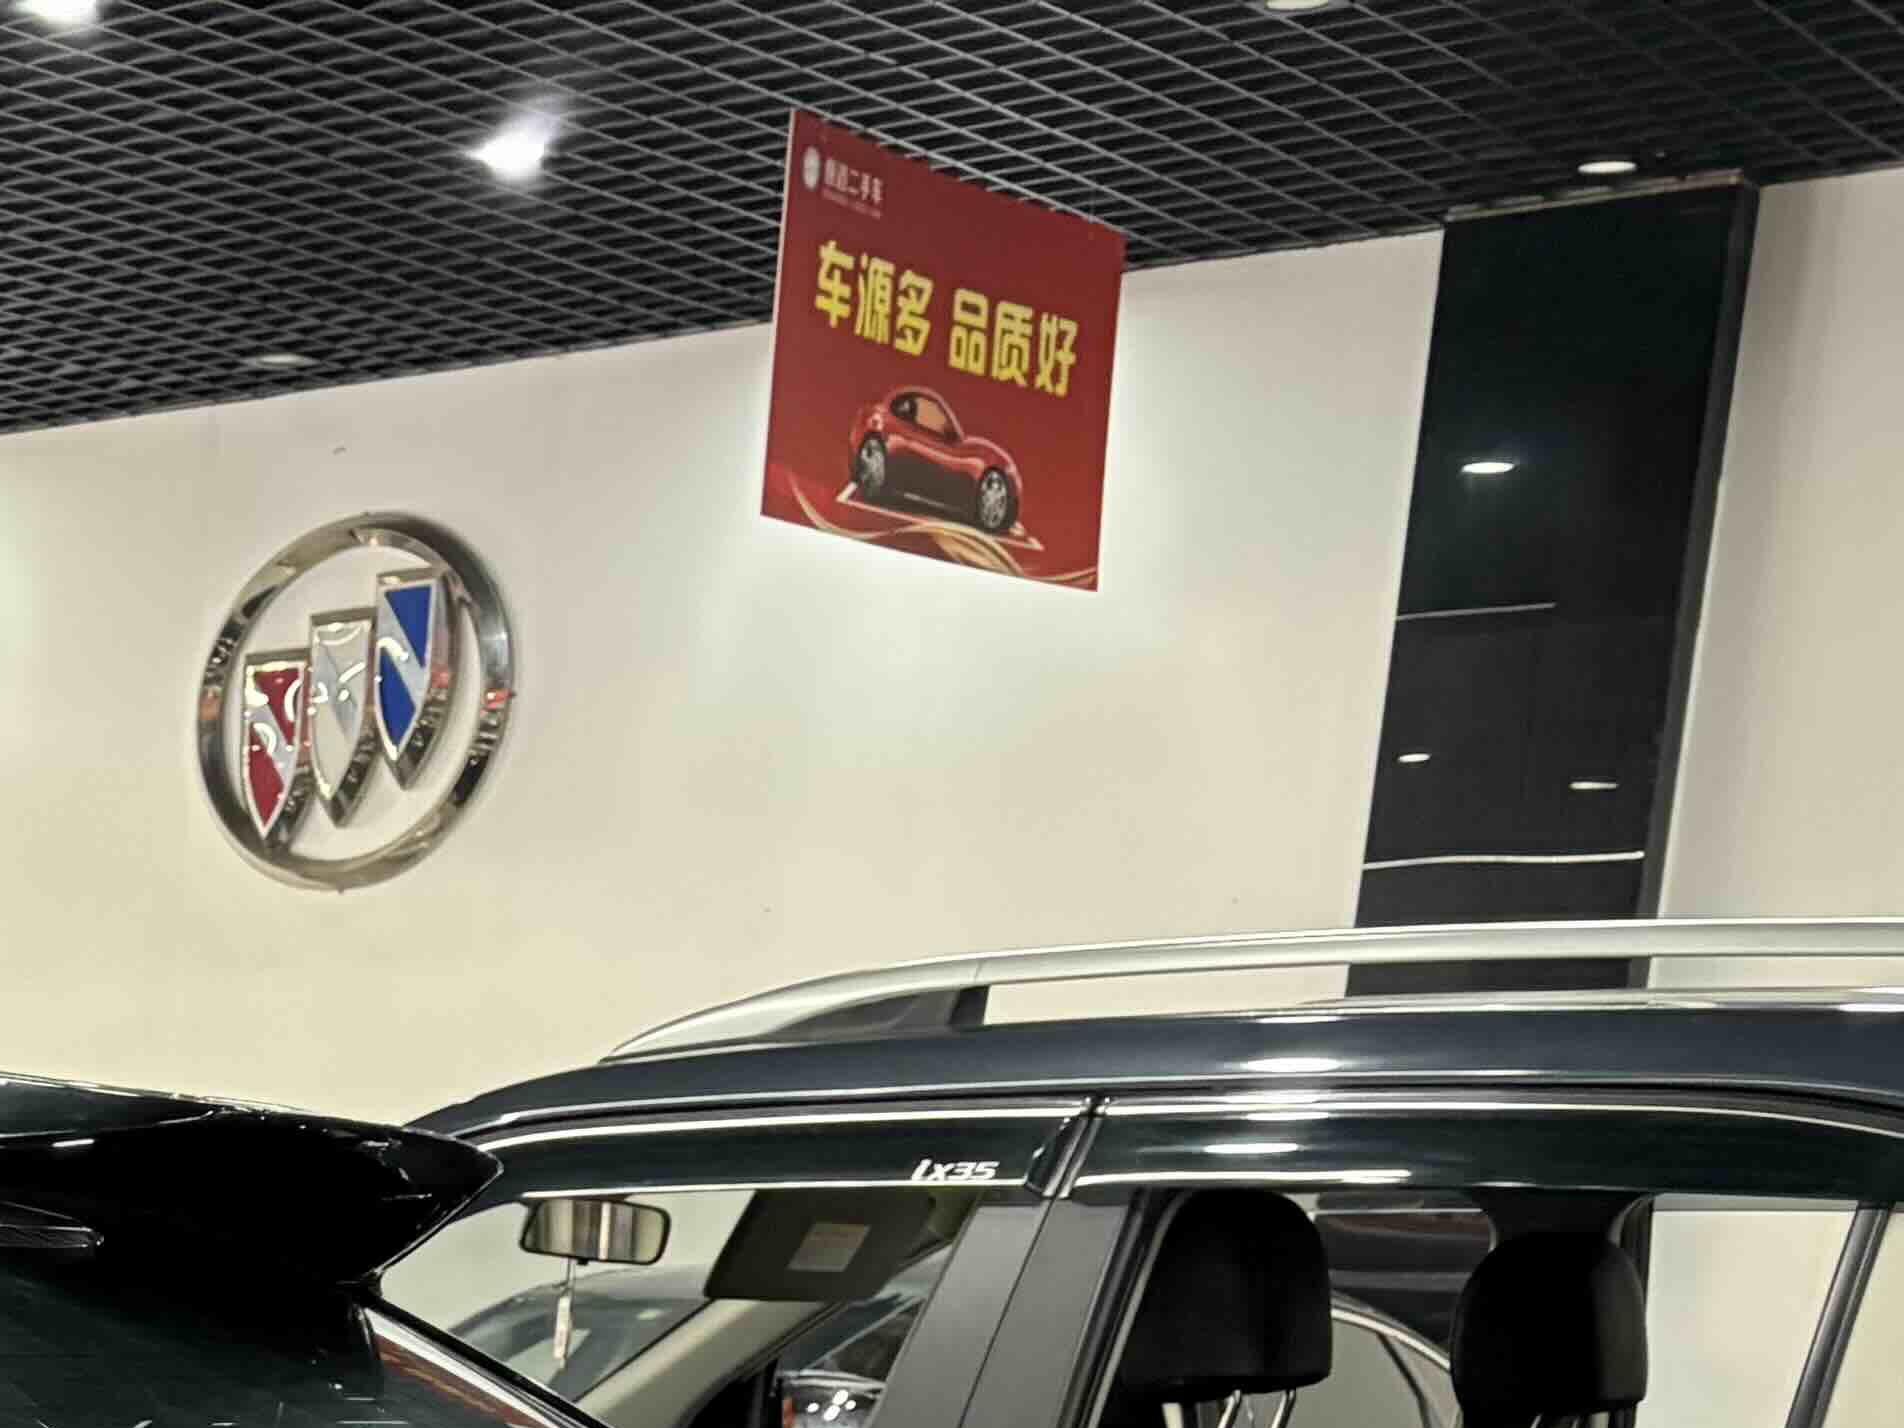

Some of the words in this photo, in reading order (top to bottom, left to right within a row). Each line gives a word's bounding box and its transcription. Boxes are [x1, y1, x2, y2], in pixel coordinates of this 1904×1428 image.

[815, 240, 933, 356] 车源多
[949, 288, 1079, 397] 品质好
